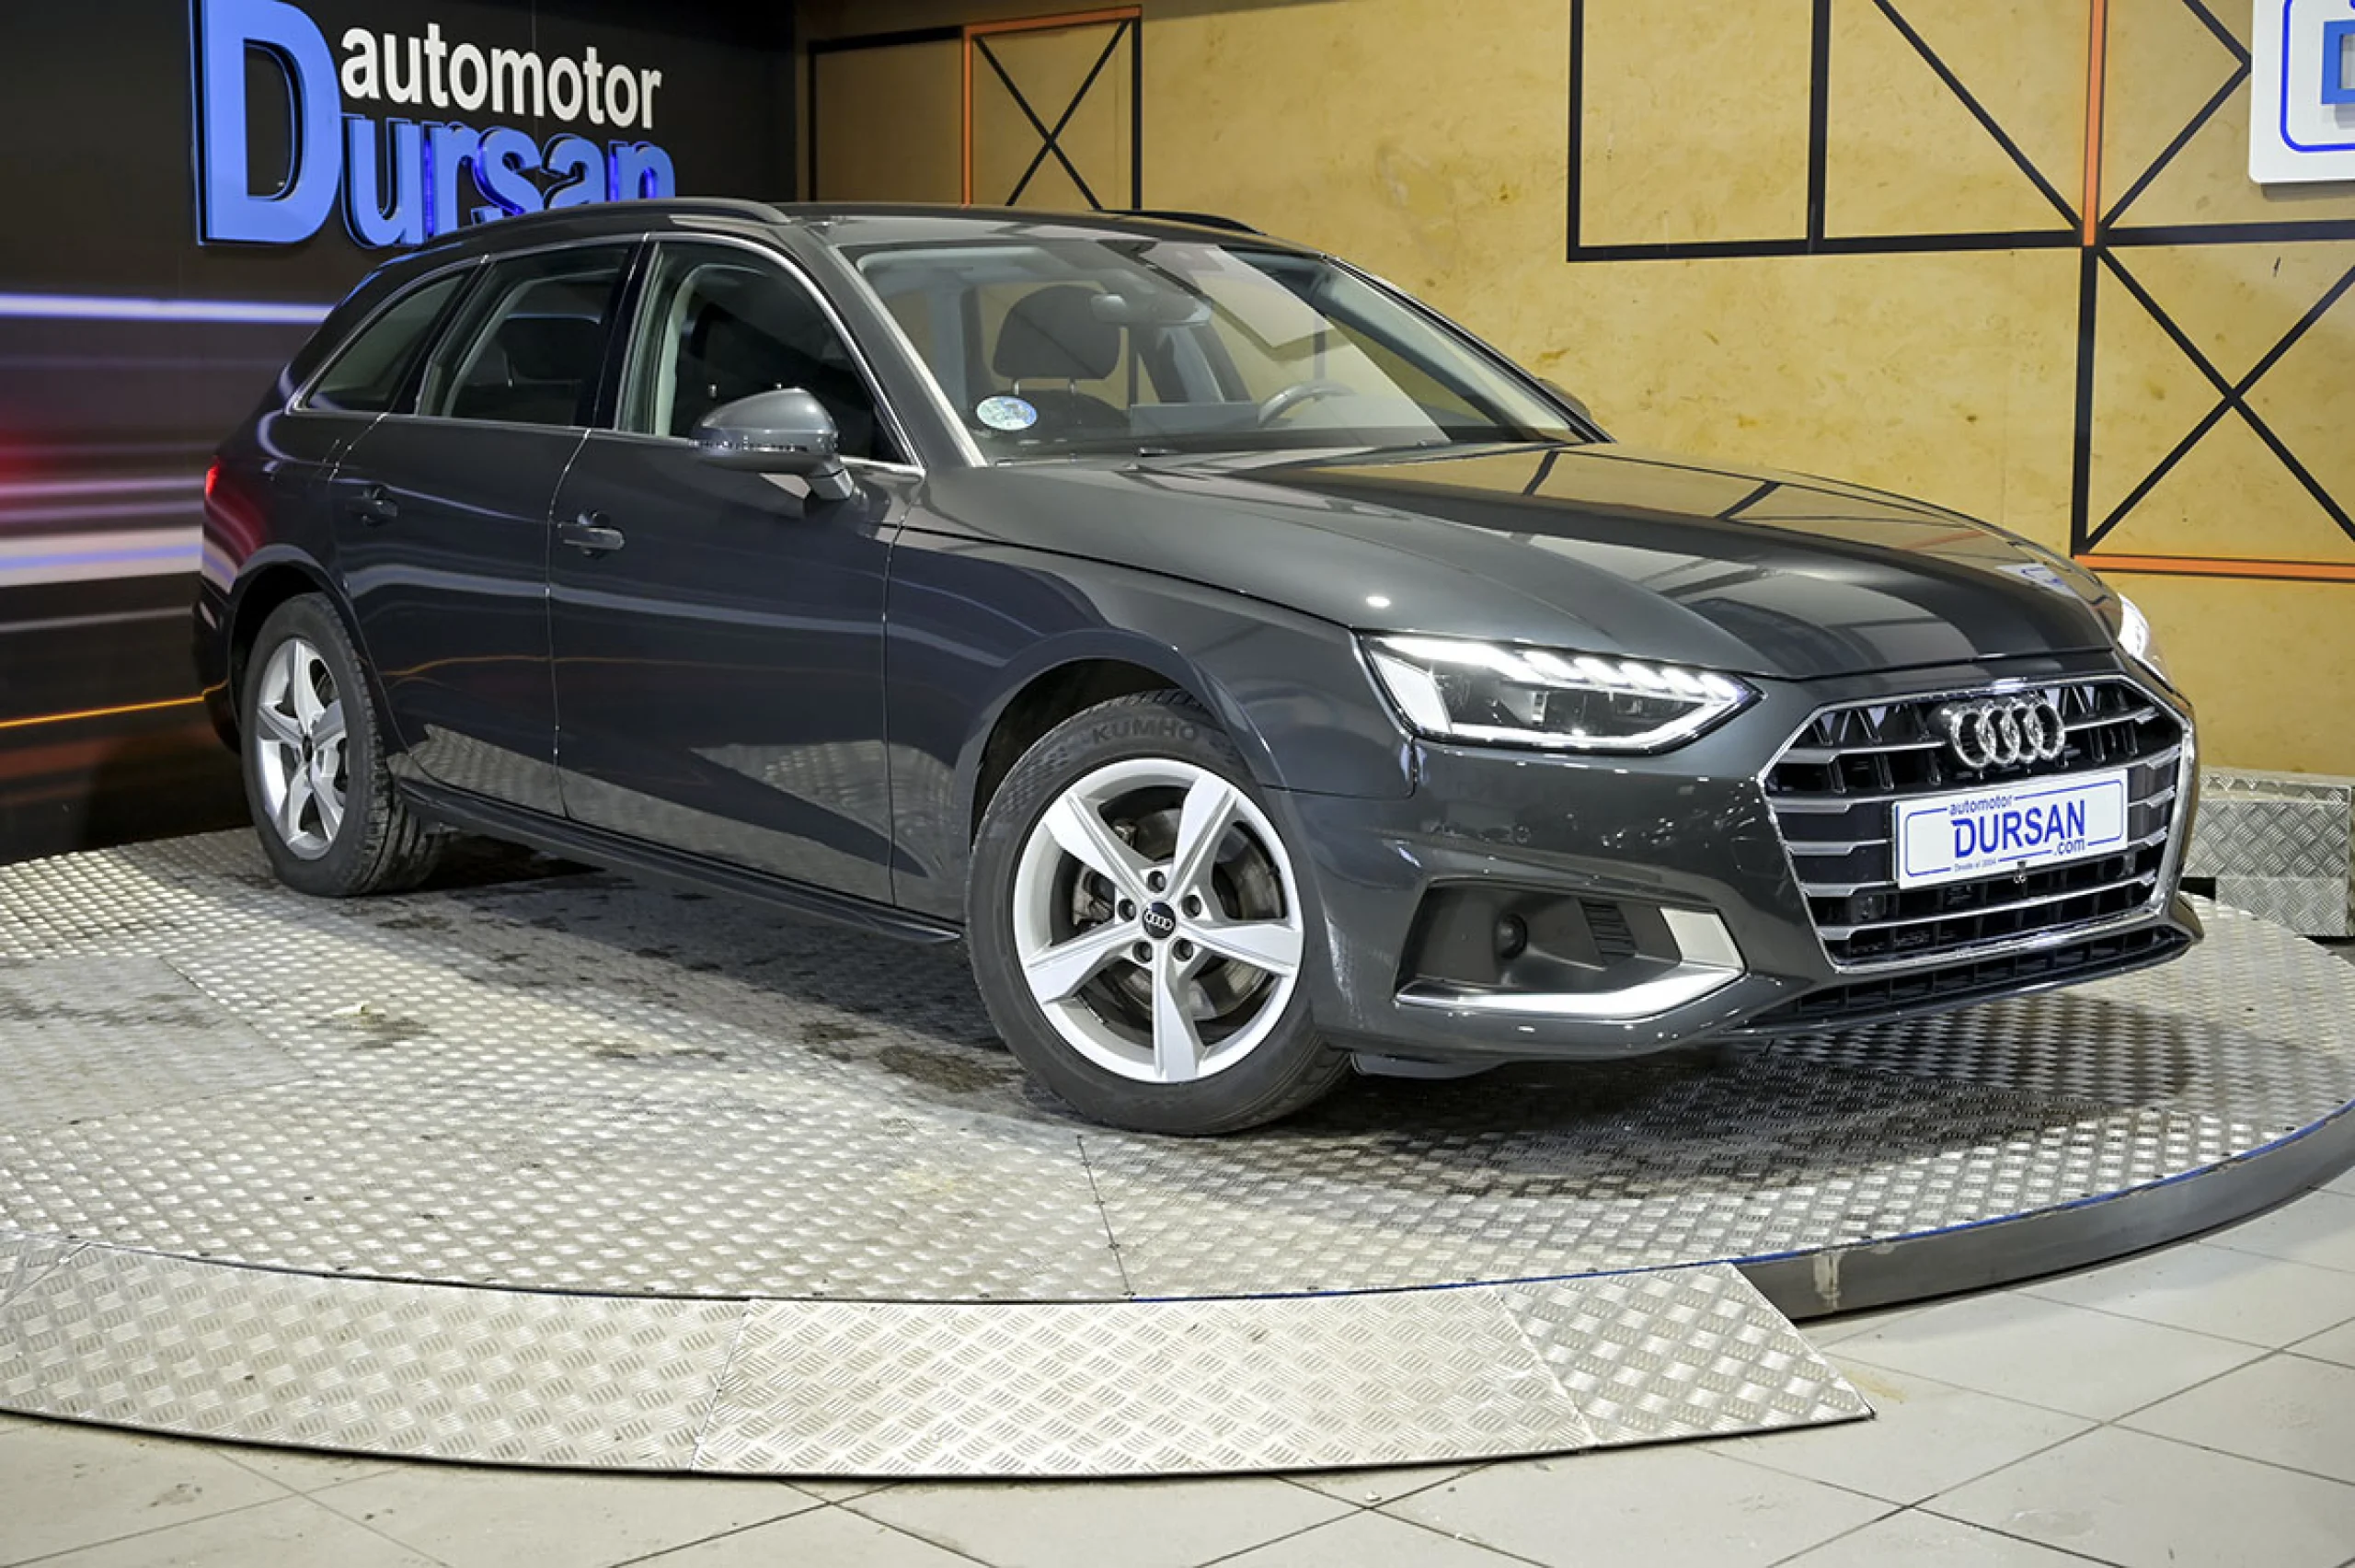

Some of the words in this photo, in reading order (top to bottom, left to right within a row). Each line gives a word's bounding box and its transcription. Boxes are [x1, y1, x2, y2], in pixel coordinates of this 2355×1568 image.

[340, 22, 662, 131] automotor
[190, 0, 676, 247] Dursan
[1092, 715, 1197, 744] KUMHO
[1948, 794, 2013, 816] automotor
[1950, 798, 2085, 859] DURSAN
[2052, 837, 2085, 856] .com
